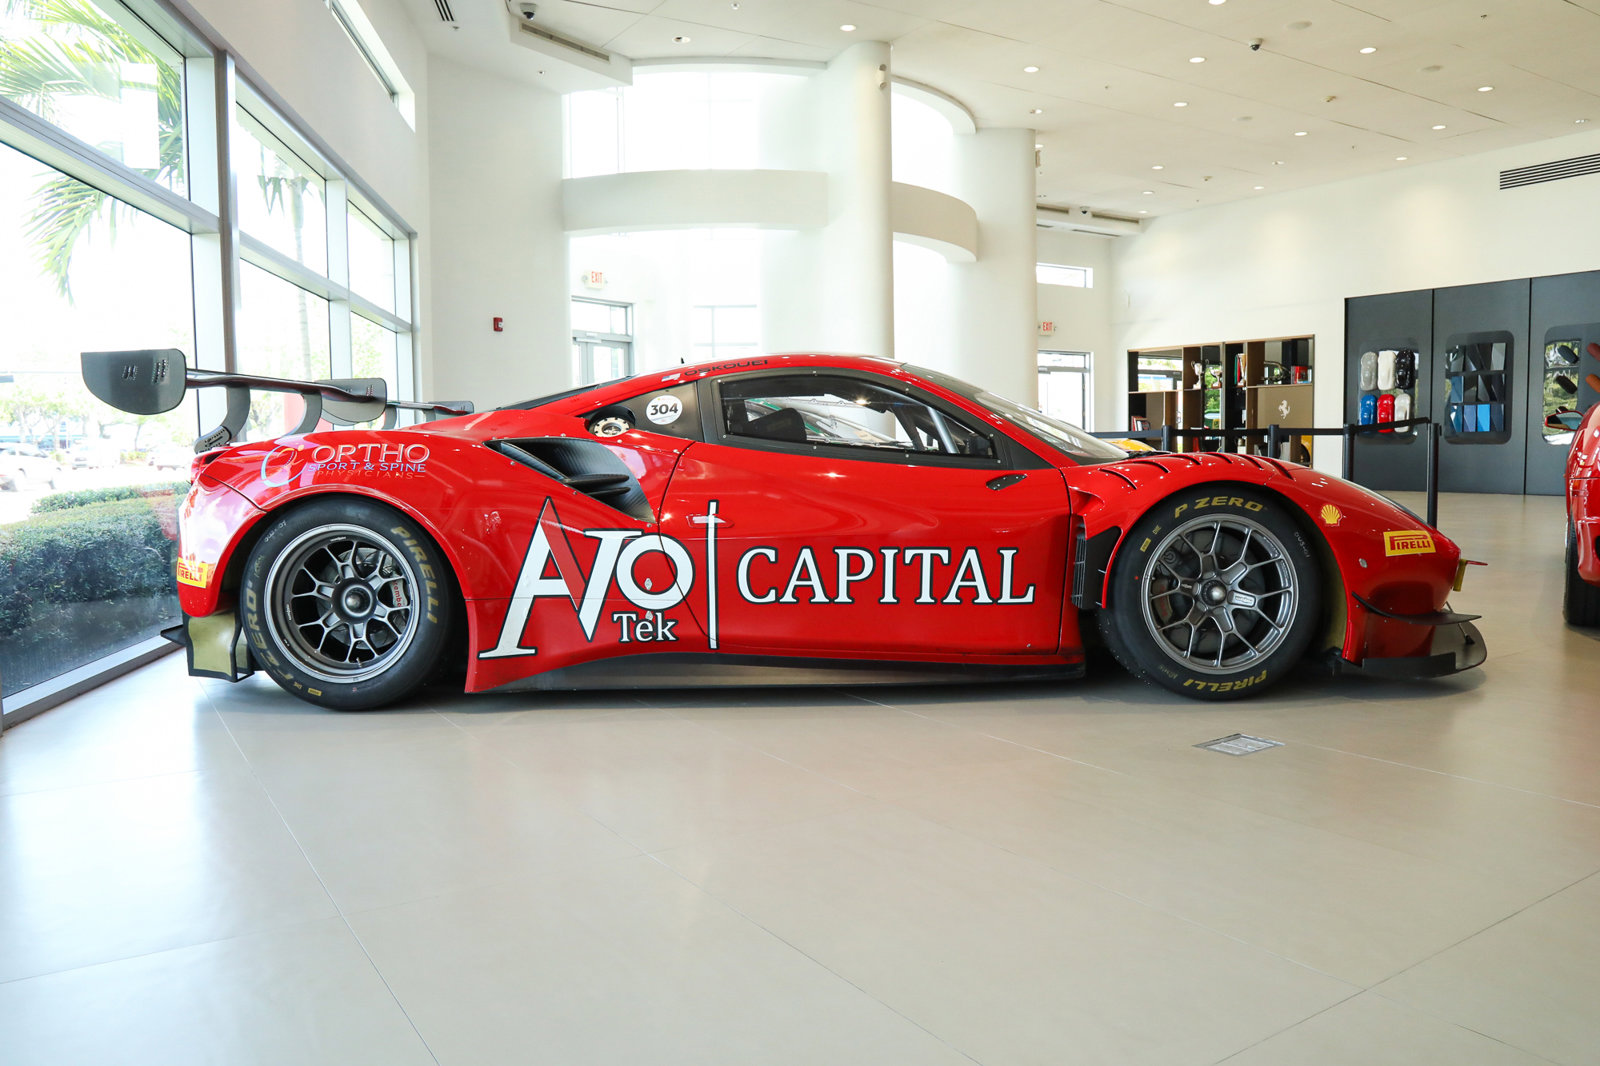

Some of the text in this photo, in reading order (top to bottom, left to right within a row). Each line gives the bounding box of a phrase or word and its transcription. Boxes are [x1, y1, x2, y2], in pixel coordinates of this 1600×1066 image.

[591, 271, 603, 283] EXIT
[684, 359, 769, 376] OSKOUEI
[650, 403, 679, 416] 304
[311, 443, 431, 464] ORTHO
[308, 462, 427, 473] SPORT & SPINE
[316, 470, 414, 480] PHYSICIANS
[1174, 496, 1263, 519] P ZERO
[1389, 534, 1431, 551] PIRELLI
[390, 526, 439, 625] PIRELLI
[736, 546, 1036, 605] CAPITAL
[246, 588, 280, 666] ZERO
[612, 610, 679, 643] Tek
[1183, 669, 1268, 692] PIRELLI
